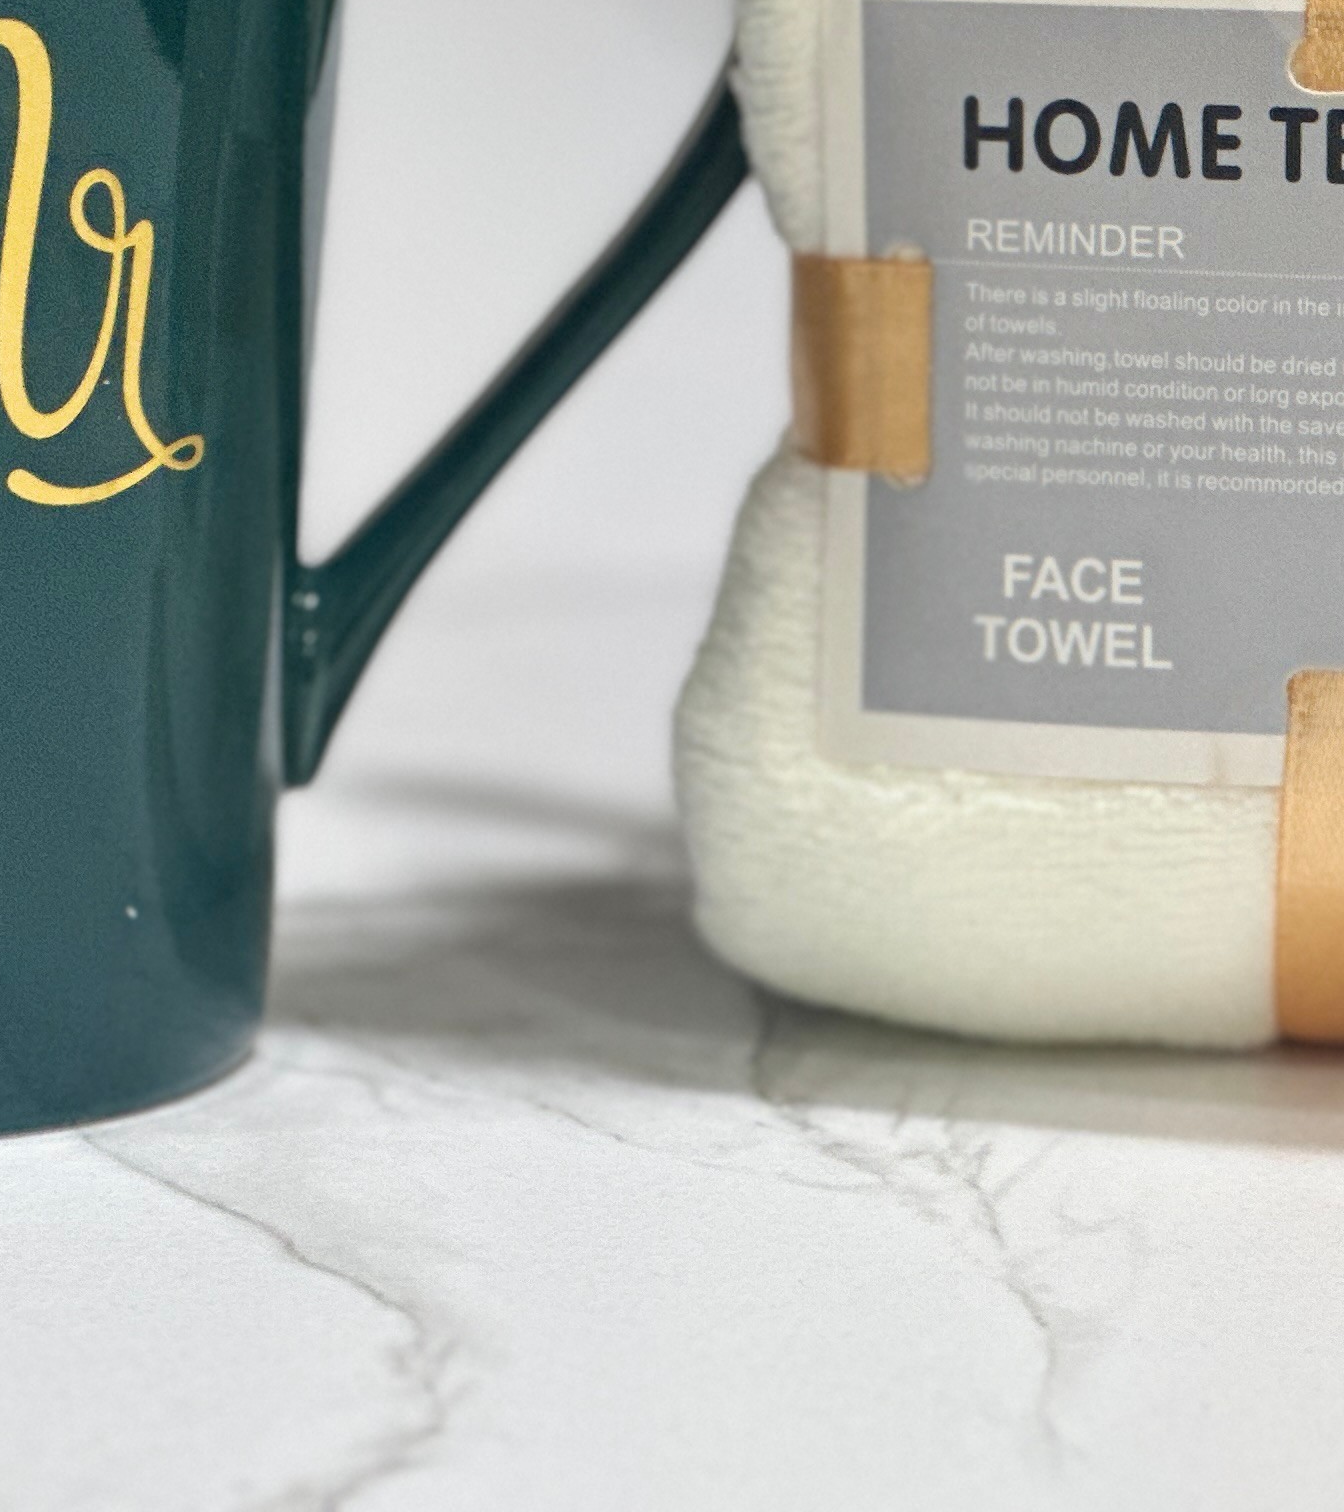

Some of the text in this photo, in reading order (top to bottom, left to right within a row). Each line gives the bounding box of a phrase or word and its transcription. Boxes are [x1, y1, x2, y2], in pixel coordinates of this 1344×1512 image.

[961, 94, 1244, 181] HOME
[965, 217, 1186, 261] REMINDER
[965, 282, 1027, 305] There
[1031, 286, 1049, 305] is
[1054, 290, 1067, 306] a
[1071, 288, 1129, 313] slight
[1215, 295, 1268, 314] color
[1273, 294, 1291, 316] in
[1297, 296, 1331, 317] the
[964, 313, 985, 332] of
[964, 342, 1015, 363] After
[1174, 351, 1245, 374] should
[1250, 353, 1277, 375] be
[1281, 354, 1337, 377] dried
[964, 374, 998, 393] not
[1001, 373, 1028, 393] be
[1031, 376, 1051, 394] in
[1056, 376, 1120, 397] humid
[1124, 380, 1218, 401] condition
[1224, 386, 1246, 403] or
[965, 401, 978, 421] It
[983, 403, 1051, 425] should
[1057, 407, 1089, 426] not
[1094, 407, 1120, 427] be
[1125, 410, 1206, 431] washed
[1212, 413, 1254, 432] with
[1259, 414, 1293, 434] the
[963, 433, 1050, 458] washing
[1143, 441, 1164, 459] or
[1169, 443, 1216, 465] your
[1298, 443, 1337, 465] this
[964, 462, 1037, 484] special
[1158, 469, 1170, 488] it
[1175, 469, 1192, 488] is
[1002, 553, 1144, 607] FACE
[973, 614, 1174, 671] TOWEL
